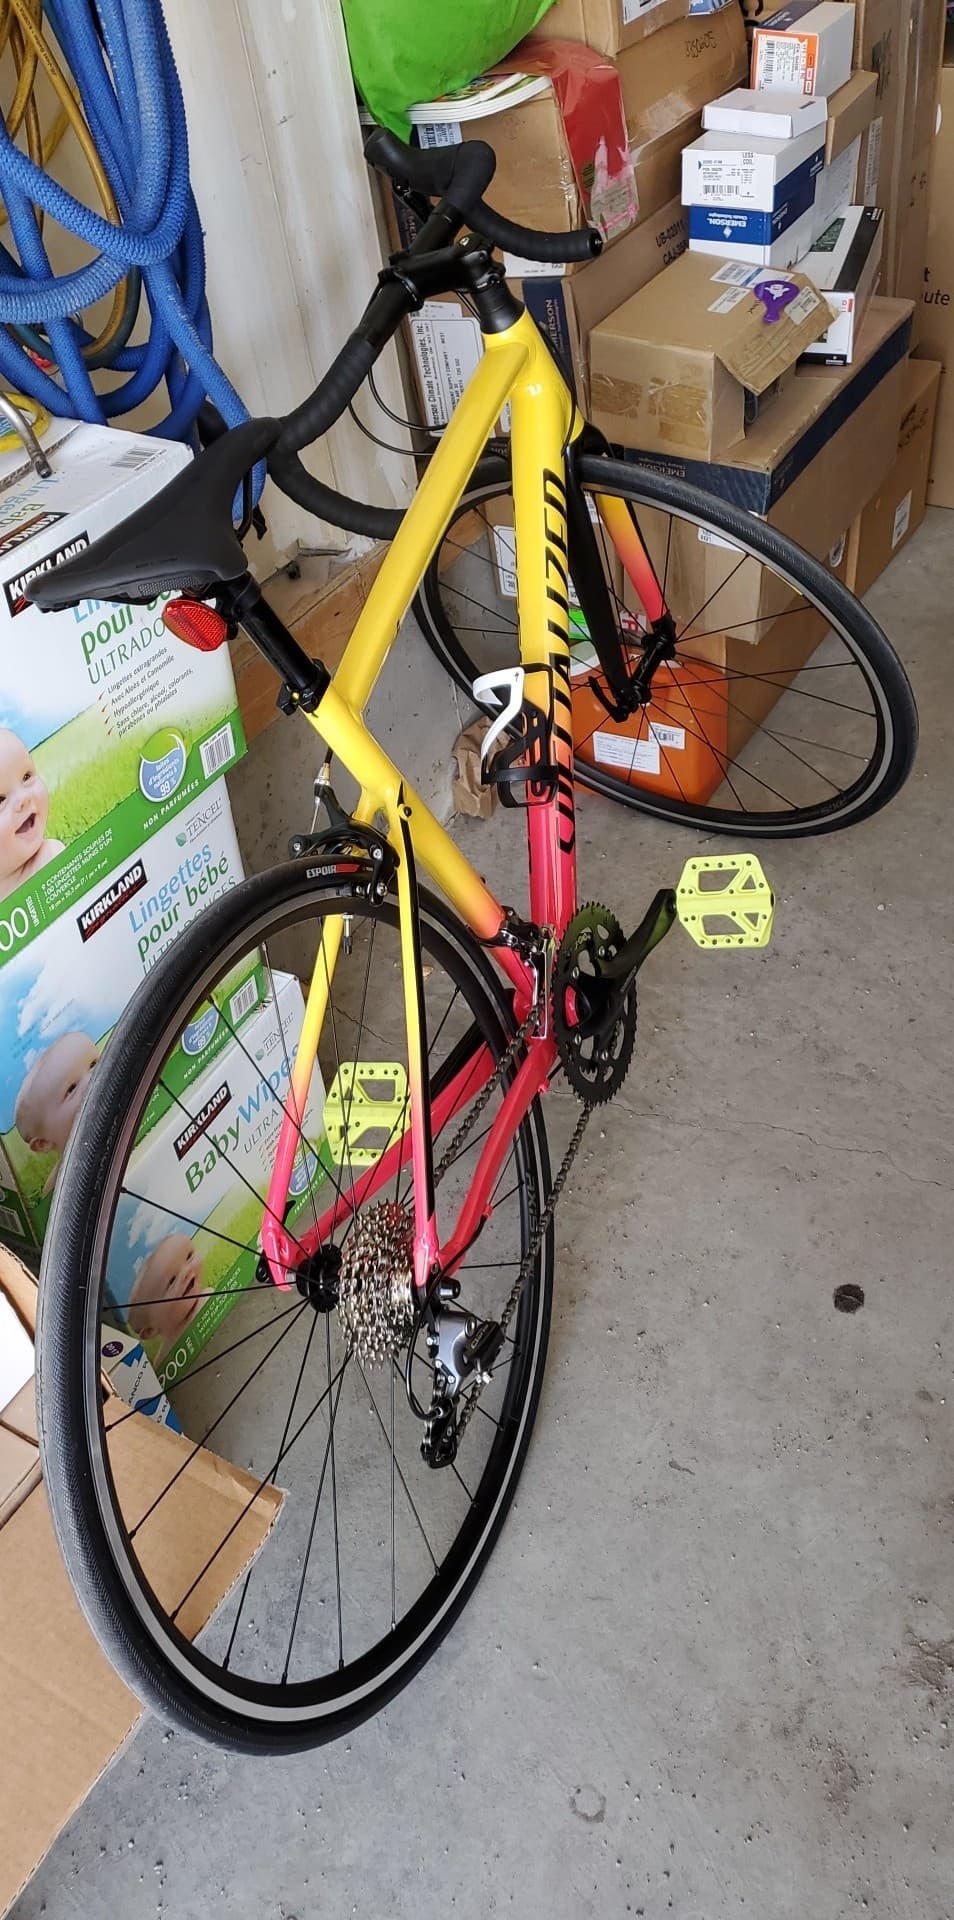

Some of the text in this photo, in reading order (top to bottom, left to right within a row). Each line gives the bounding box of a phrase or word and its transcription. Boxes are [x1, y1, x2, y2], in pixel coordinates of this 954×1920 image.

[706, 218, 747, 228] EMERSON
[921, 289, 950, 306] ute
[426, 380, 436, 402] Climate
[430, 404, 440, 426] merson
[108, 671, 132, 694] Lingettes
[111, 693, 124, 705] Avec
[140, 676, 146, 684] et
[116, 716, 130, 729] Sans
[160, 780, 170, 796] 99
[143, 778, 199, 830] NON PARFUMÉES
[186, 801, 221, 836] TENCEL
[306, 864, 337, 879] ESPOIR
[46, 876, 76, 904] COUVERCLE
[80, 866, 142, 930] KIRKLAND
[128, 844, 212, 933] Lingettes
[137, 850, 230, 962] pour bébé
[176, 1086, 228, 1150] KIRKLAND
[185, 1115, 240, 1193] Baby
